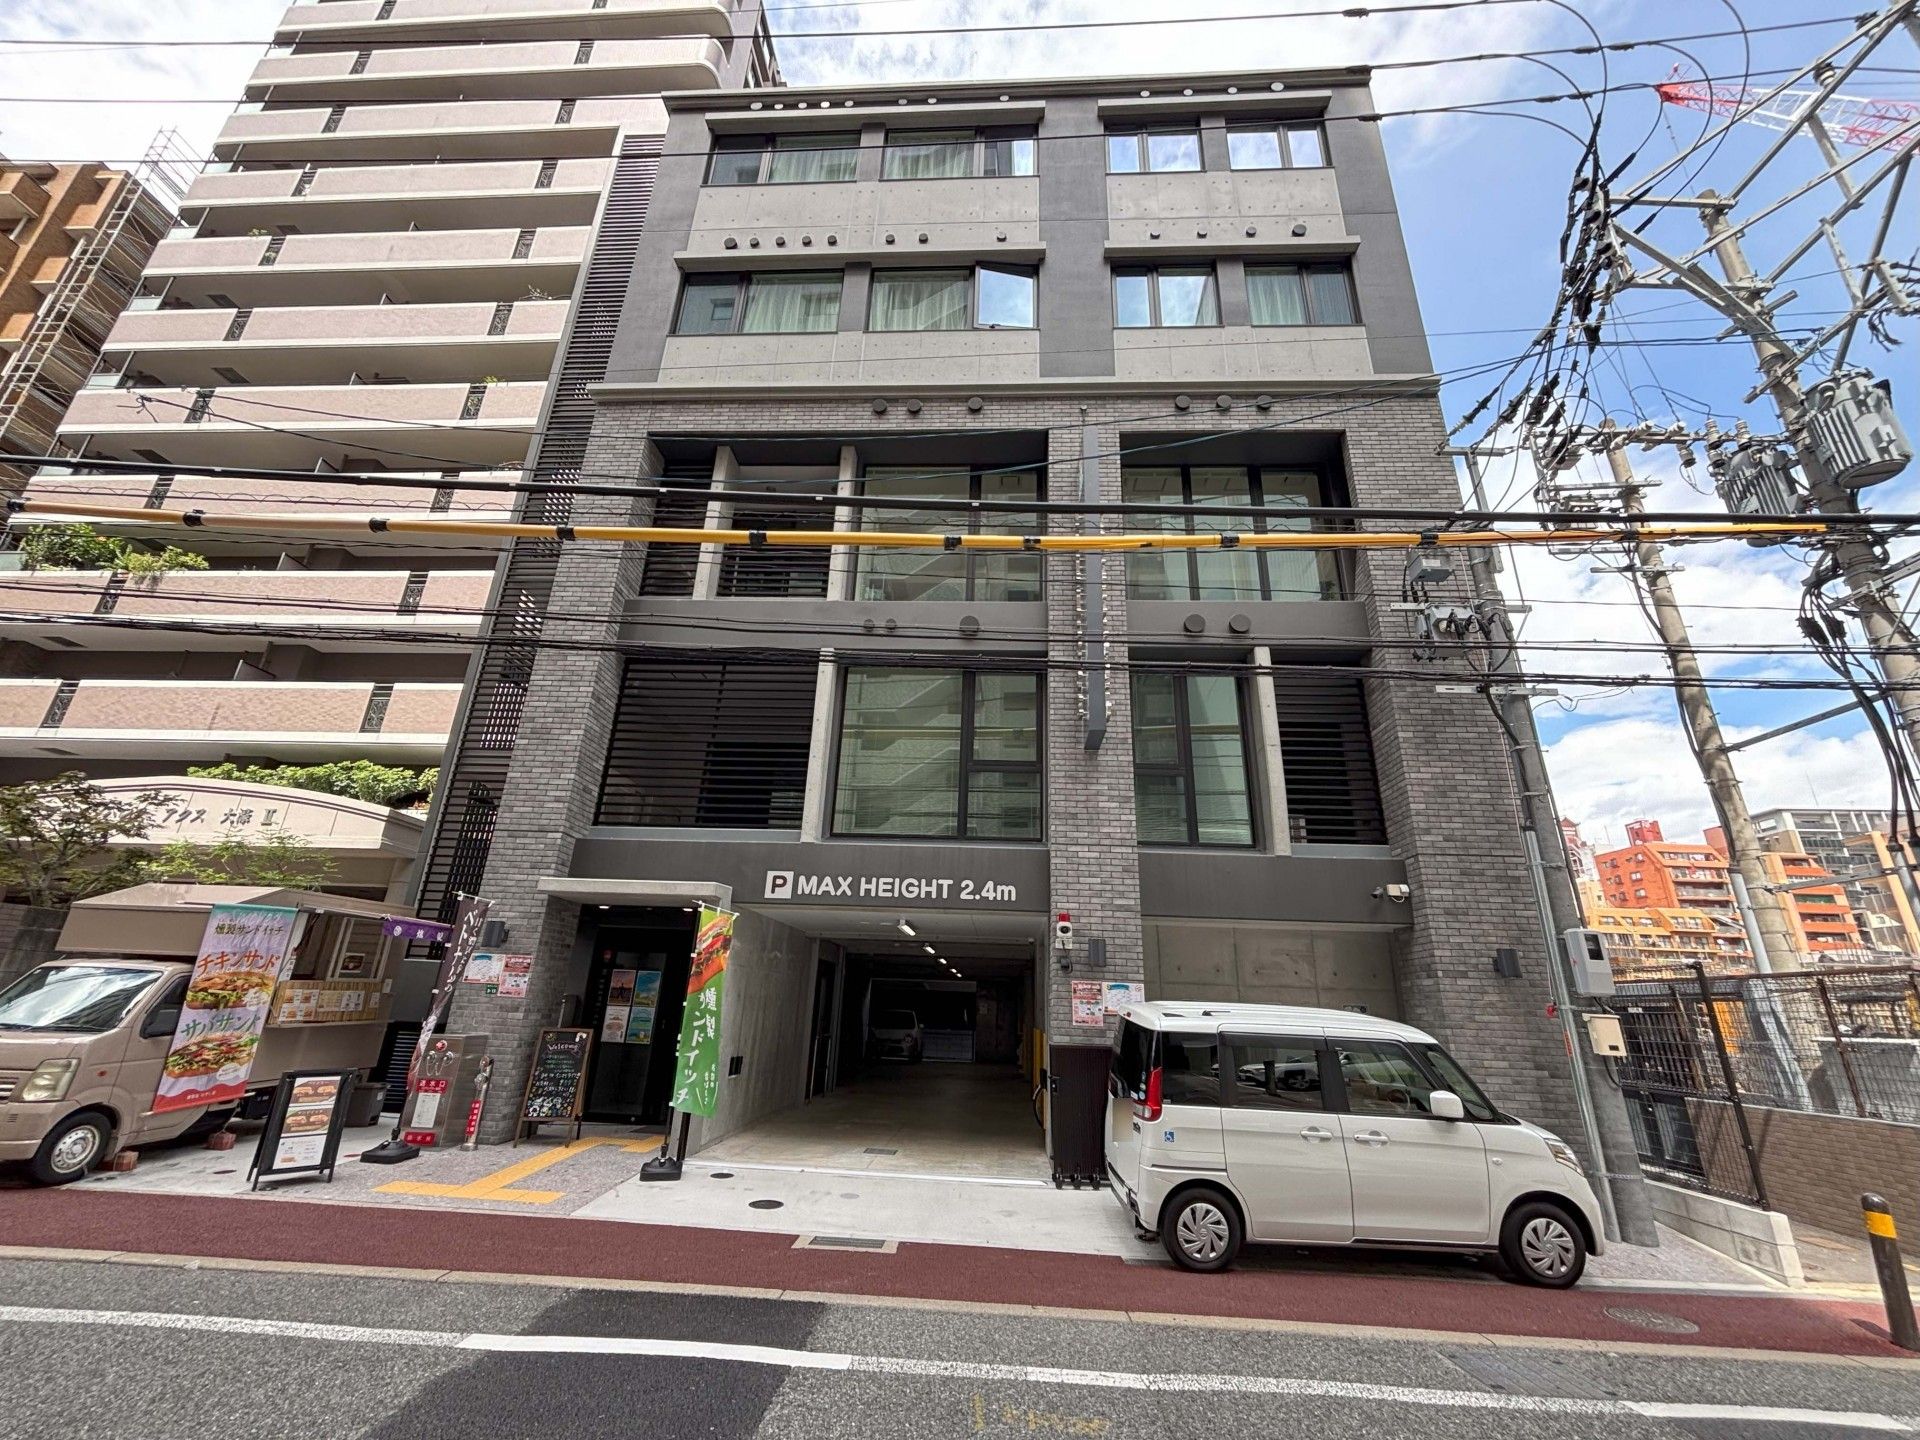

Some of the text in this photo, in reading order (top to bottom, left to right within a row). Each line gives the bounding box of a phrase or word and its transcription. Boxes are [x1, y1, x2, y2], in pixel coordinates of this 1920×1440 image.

[797, 875, 853, 896] MAX
[859, 876, 953, 899] HEIGHT
[959, 879, 1017, 901] 2.4m
[197, 949, 281, 974] チキンサンド
[676, 992, 706, 1104] サンドイッチ
